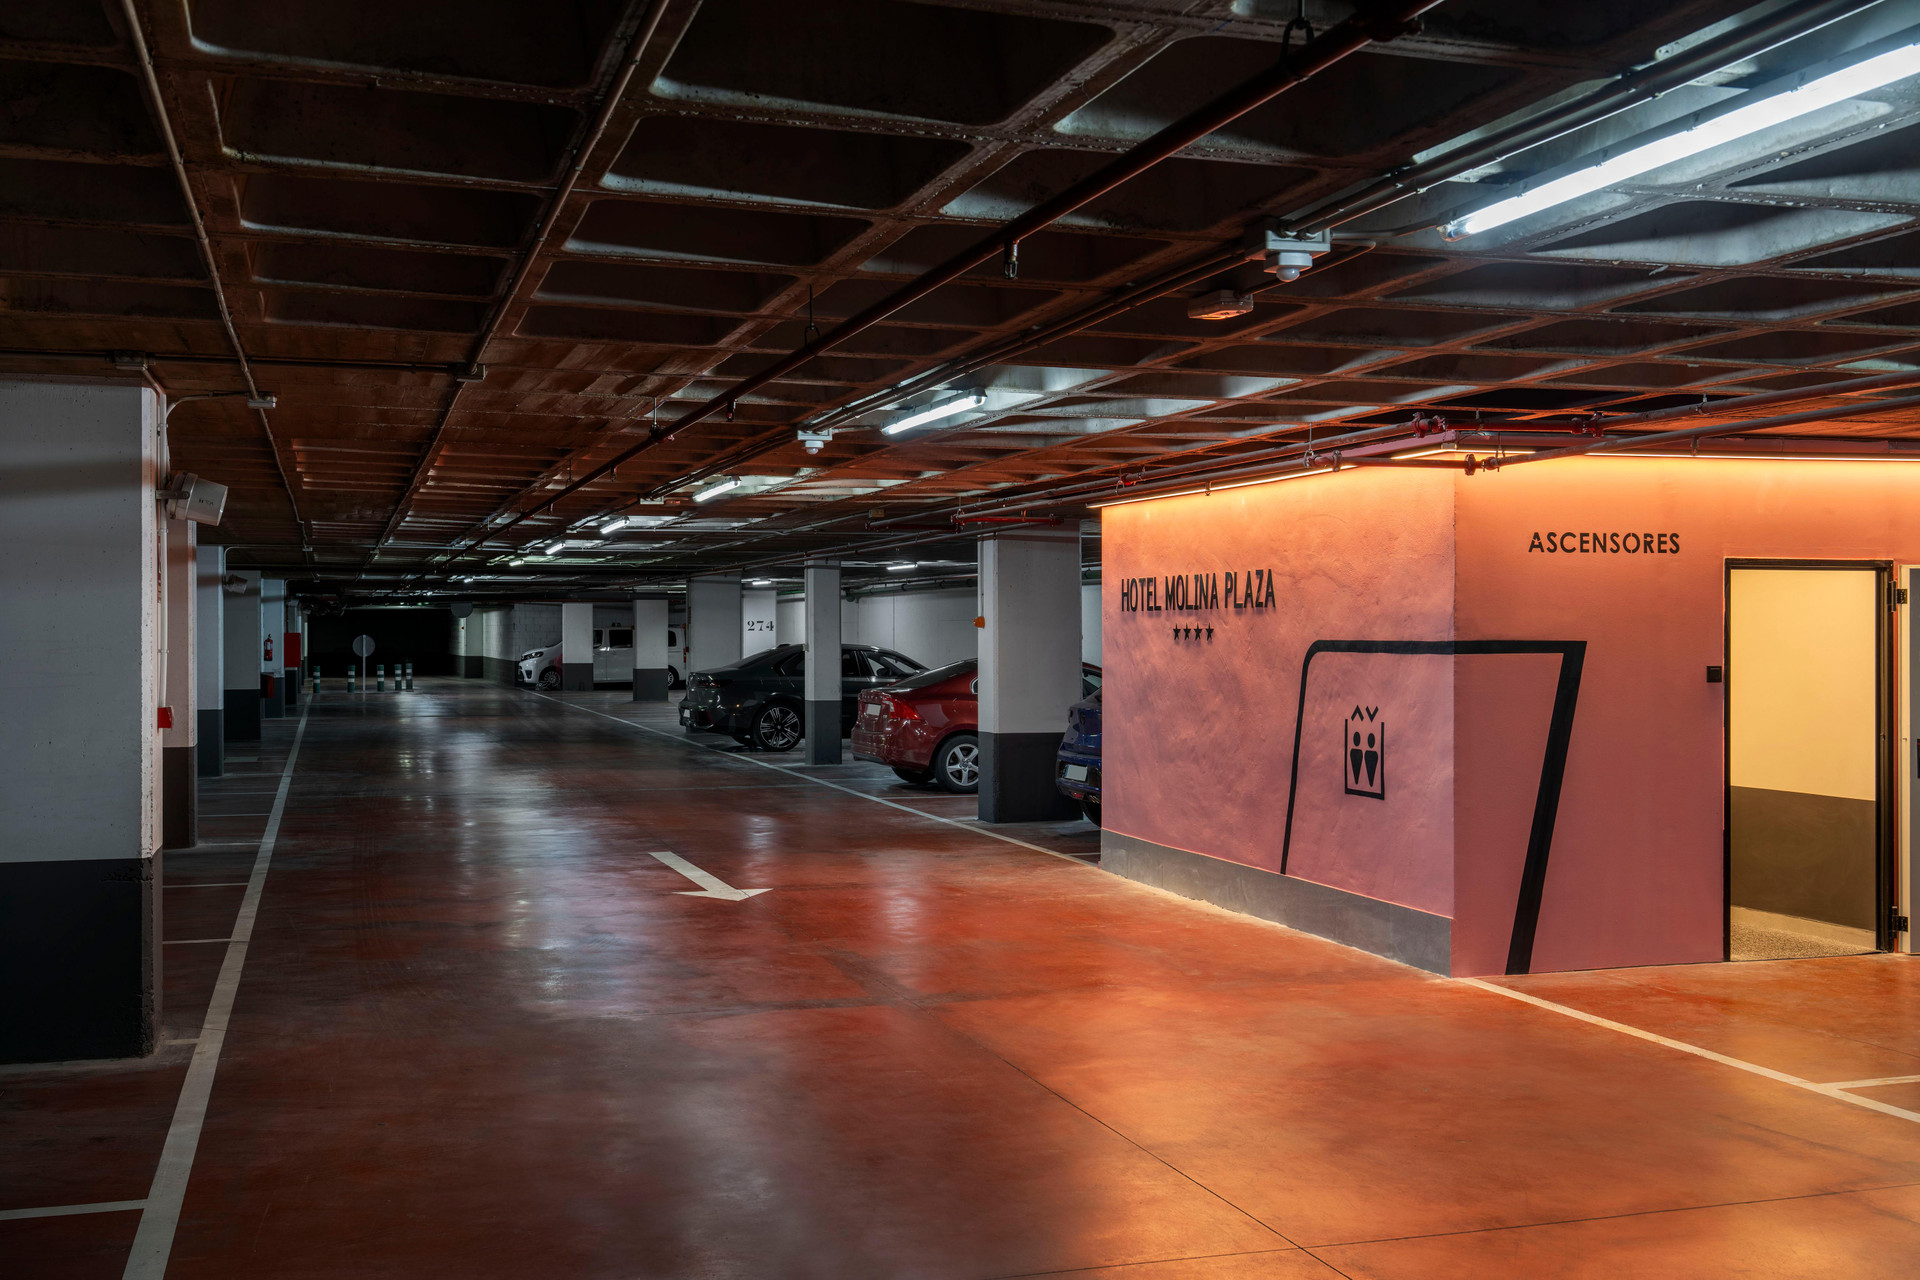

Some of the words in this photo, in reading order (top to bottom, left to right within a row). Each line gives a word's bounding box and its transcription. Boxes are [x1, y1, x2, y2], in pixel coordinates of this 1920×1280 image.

[1528, 532, 1680, 554] ASCENSORES
[1121, 577, 1162, 612] HOTEL
[1165, 573, 1219, 611] MOLINA
[1224, 569, 1276, 609] PLAZA
[747, 620, 775, 631] 274
